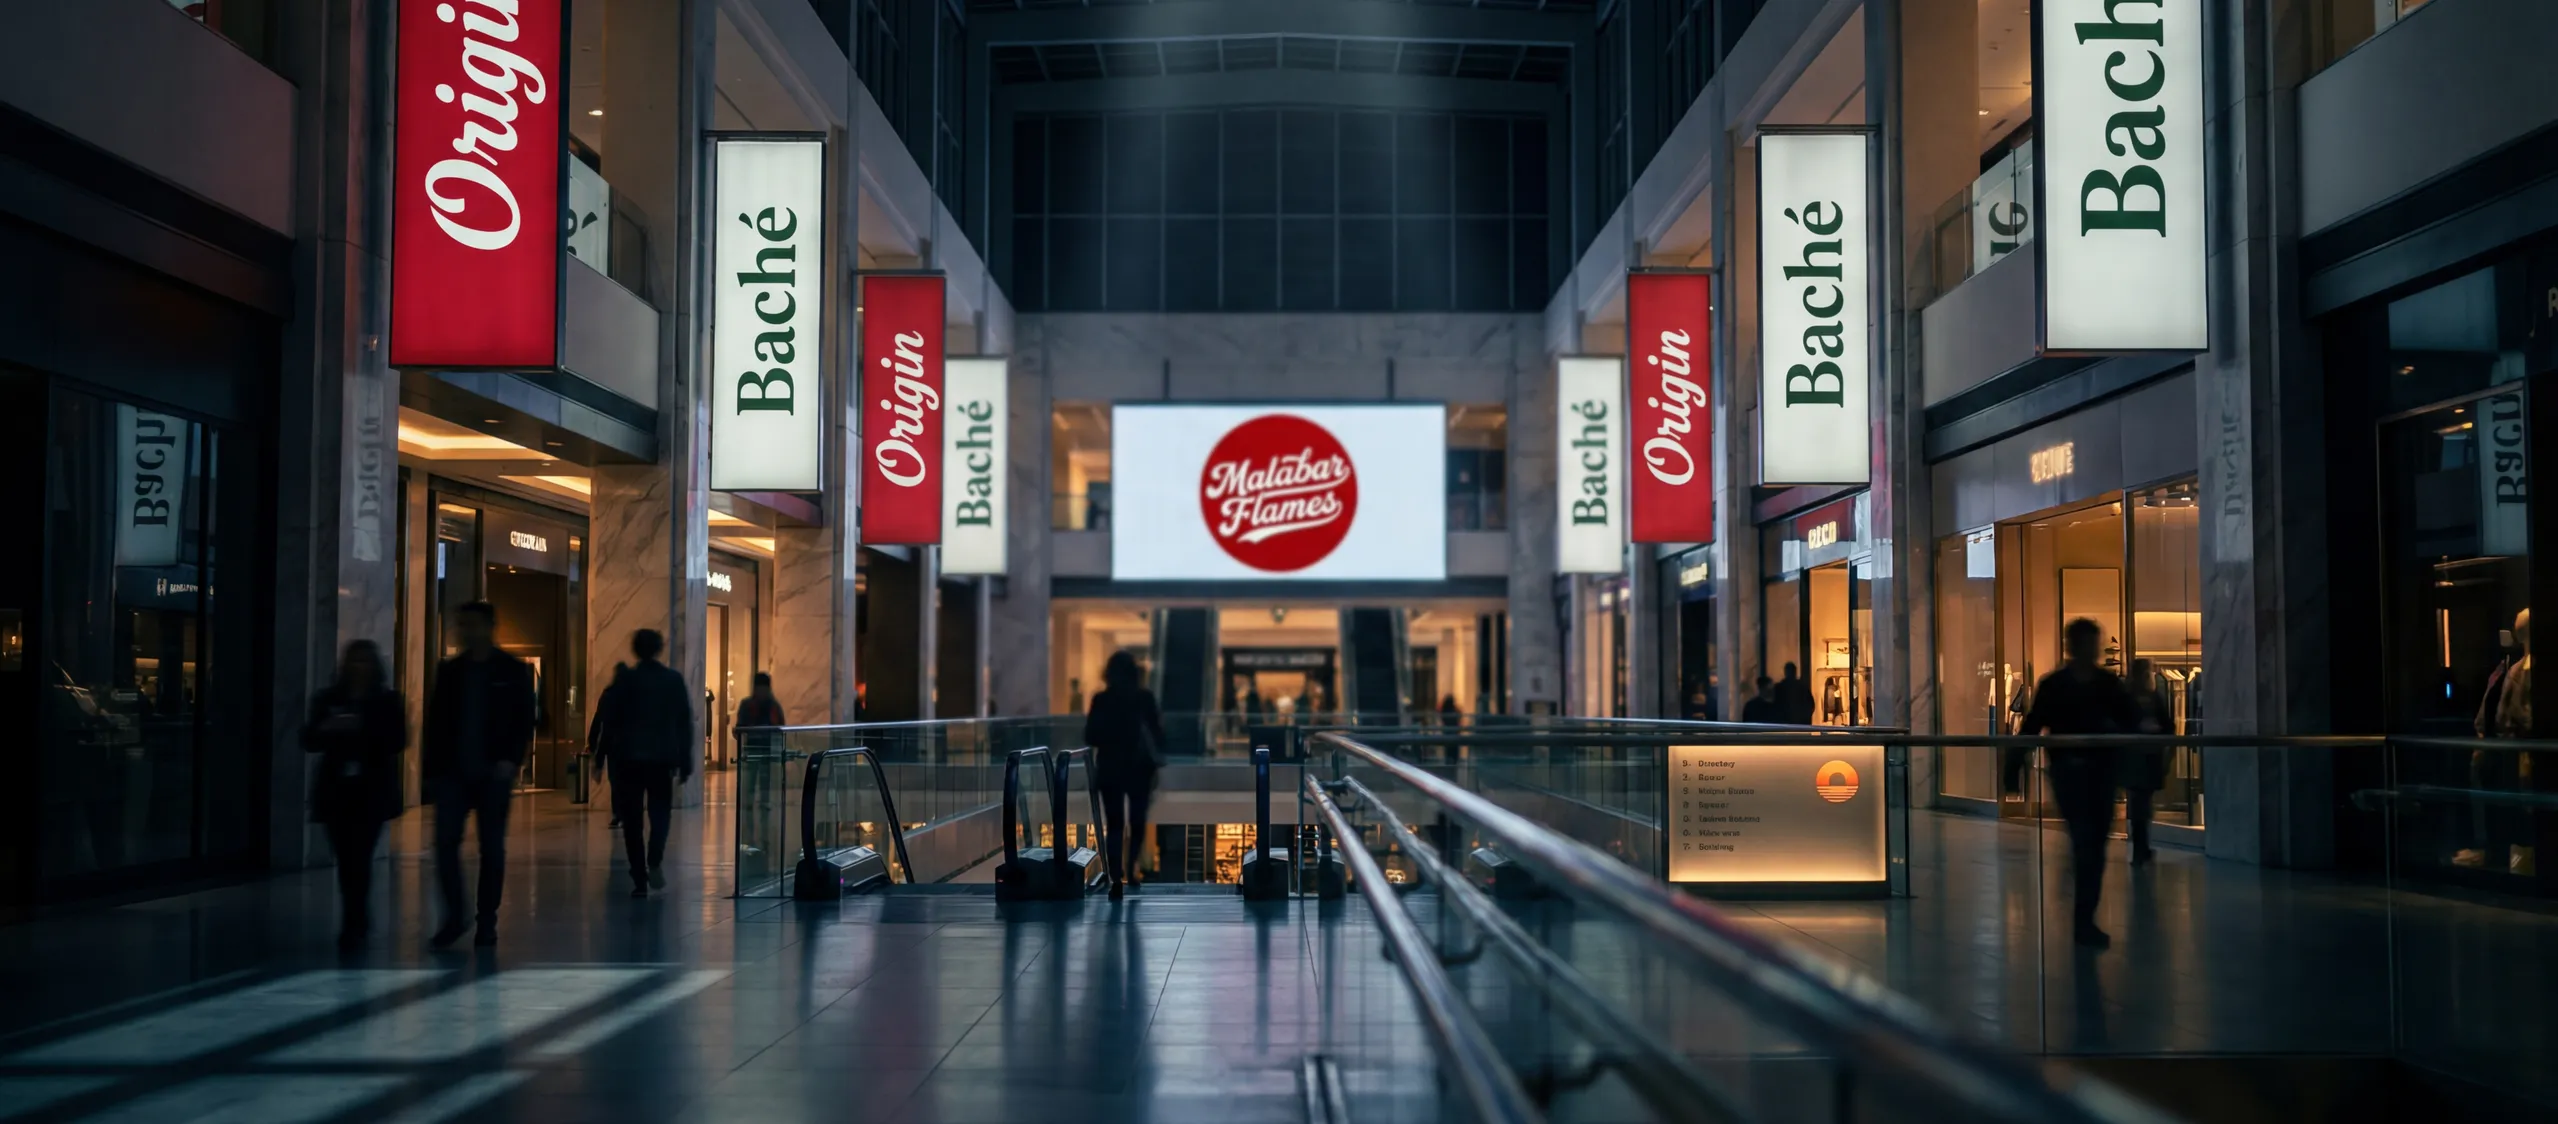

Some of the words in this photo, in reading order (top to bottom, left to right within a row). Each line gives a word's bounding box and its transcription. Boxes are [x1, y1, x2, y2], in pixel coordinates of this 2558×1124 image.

[425, 0, 546, 251] Origi
[737, 205, 798, 416] Baché
[1783, 200, 1844, 409] Baché
[875, 330, 939, 488] Origin
[955, 399, 993, 528] Baché
[1205, 446, 1350, 499] Malabar
[1571, 399, 1608, 526] Baché
[1643, 328, 1706, 486] Origin
[1217, 491, 1343, 543] Flames
